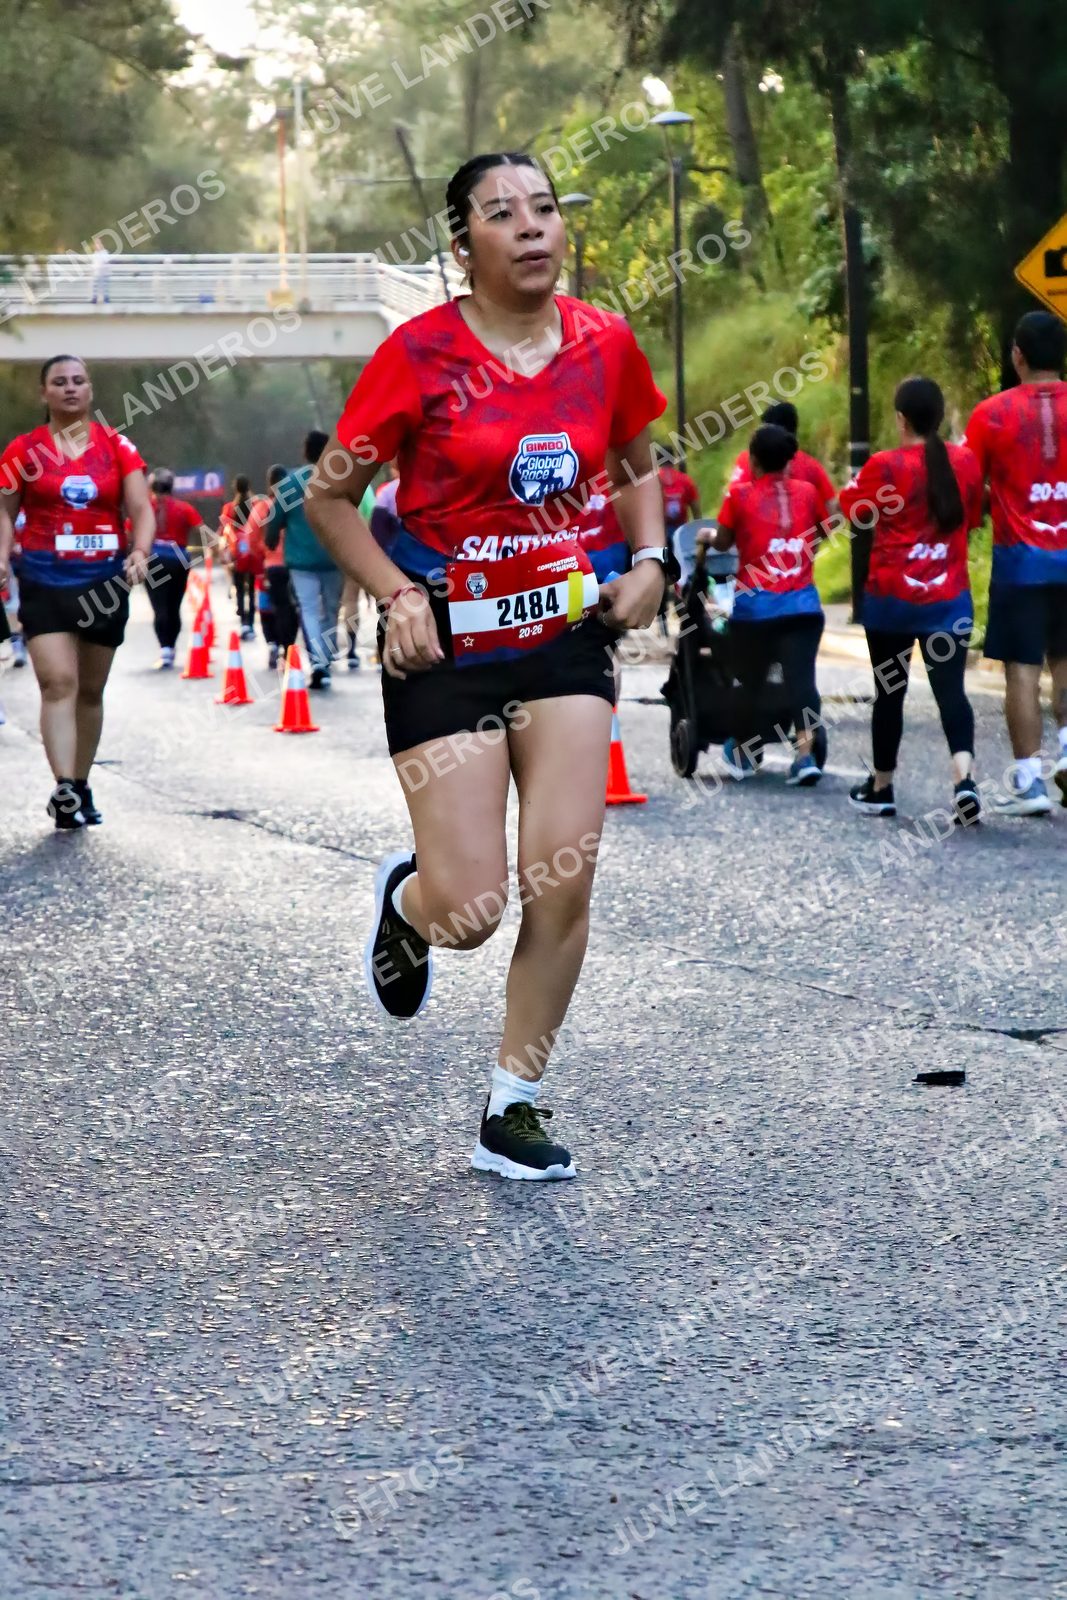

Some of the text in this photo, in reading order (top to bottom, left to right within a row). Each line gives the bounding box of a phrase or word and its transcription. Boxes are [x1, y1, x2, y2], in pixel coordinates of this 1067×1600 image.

[526, 441, 563, 452] BIMBO
[527, 455, 564, 470] Global
[520, 469, 550, 481] Race
[75, 535, 103, 549] 2063
[497, 587, 560, 627] 2484
